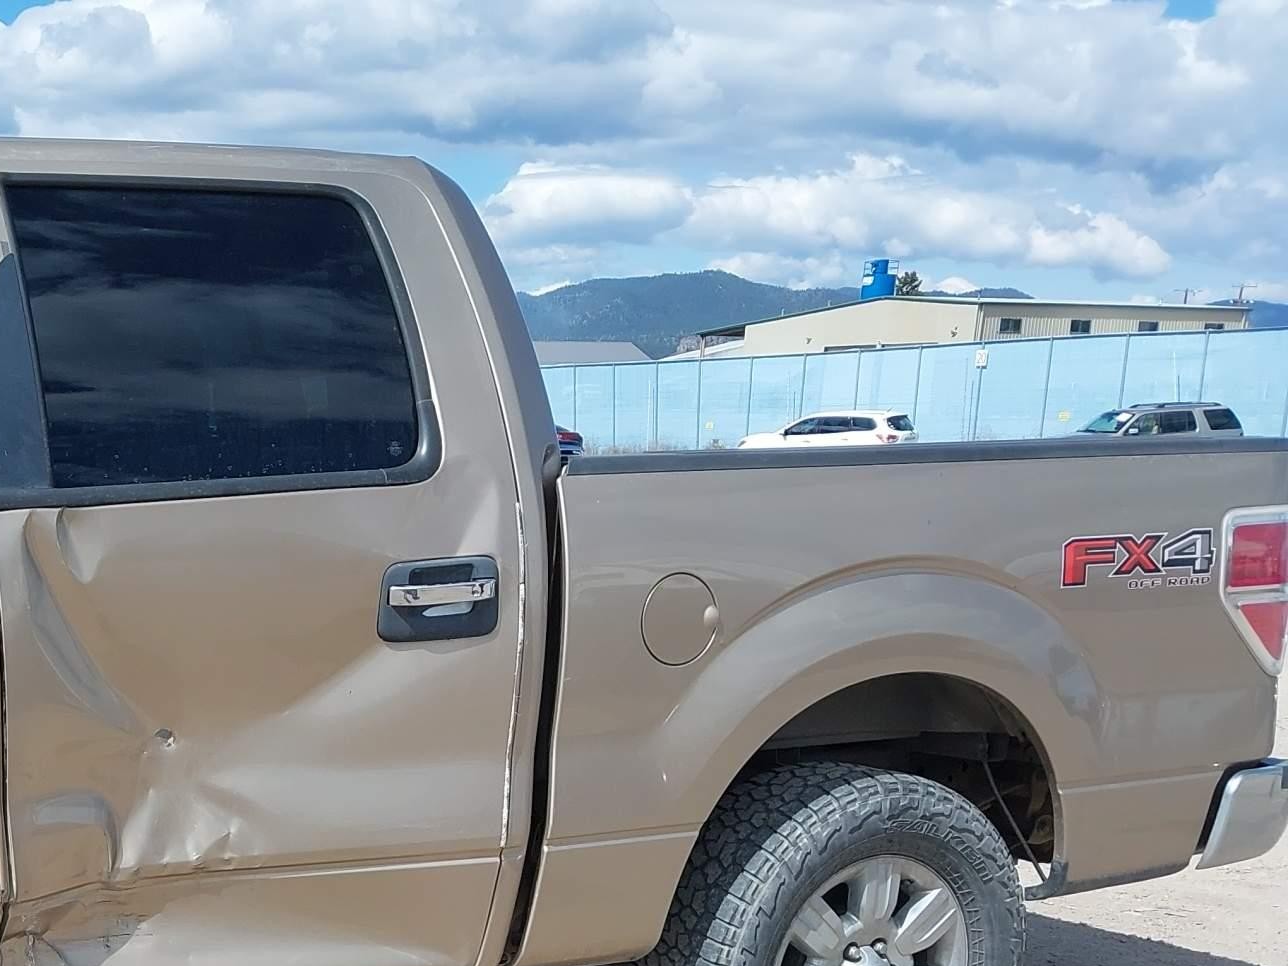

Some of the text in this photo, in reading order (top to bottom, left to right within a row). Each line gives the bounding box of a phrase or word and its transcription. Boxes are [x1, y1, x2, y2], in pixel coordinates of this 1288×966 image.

[1061, 528, 1215, 588] FX4
[1128, 576, 1210, 589] OFF ROAD
